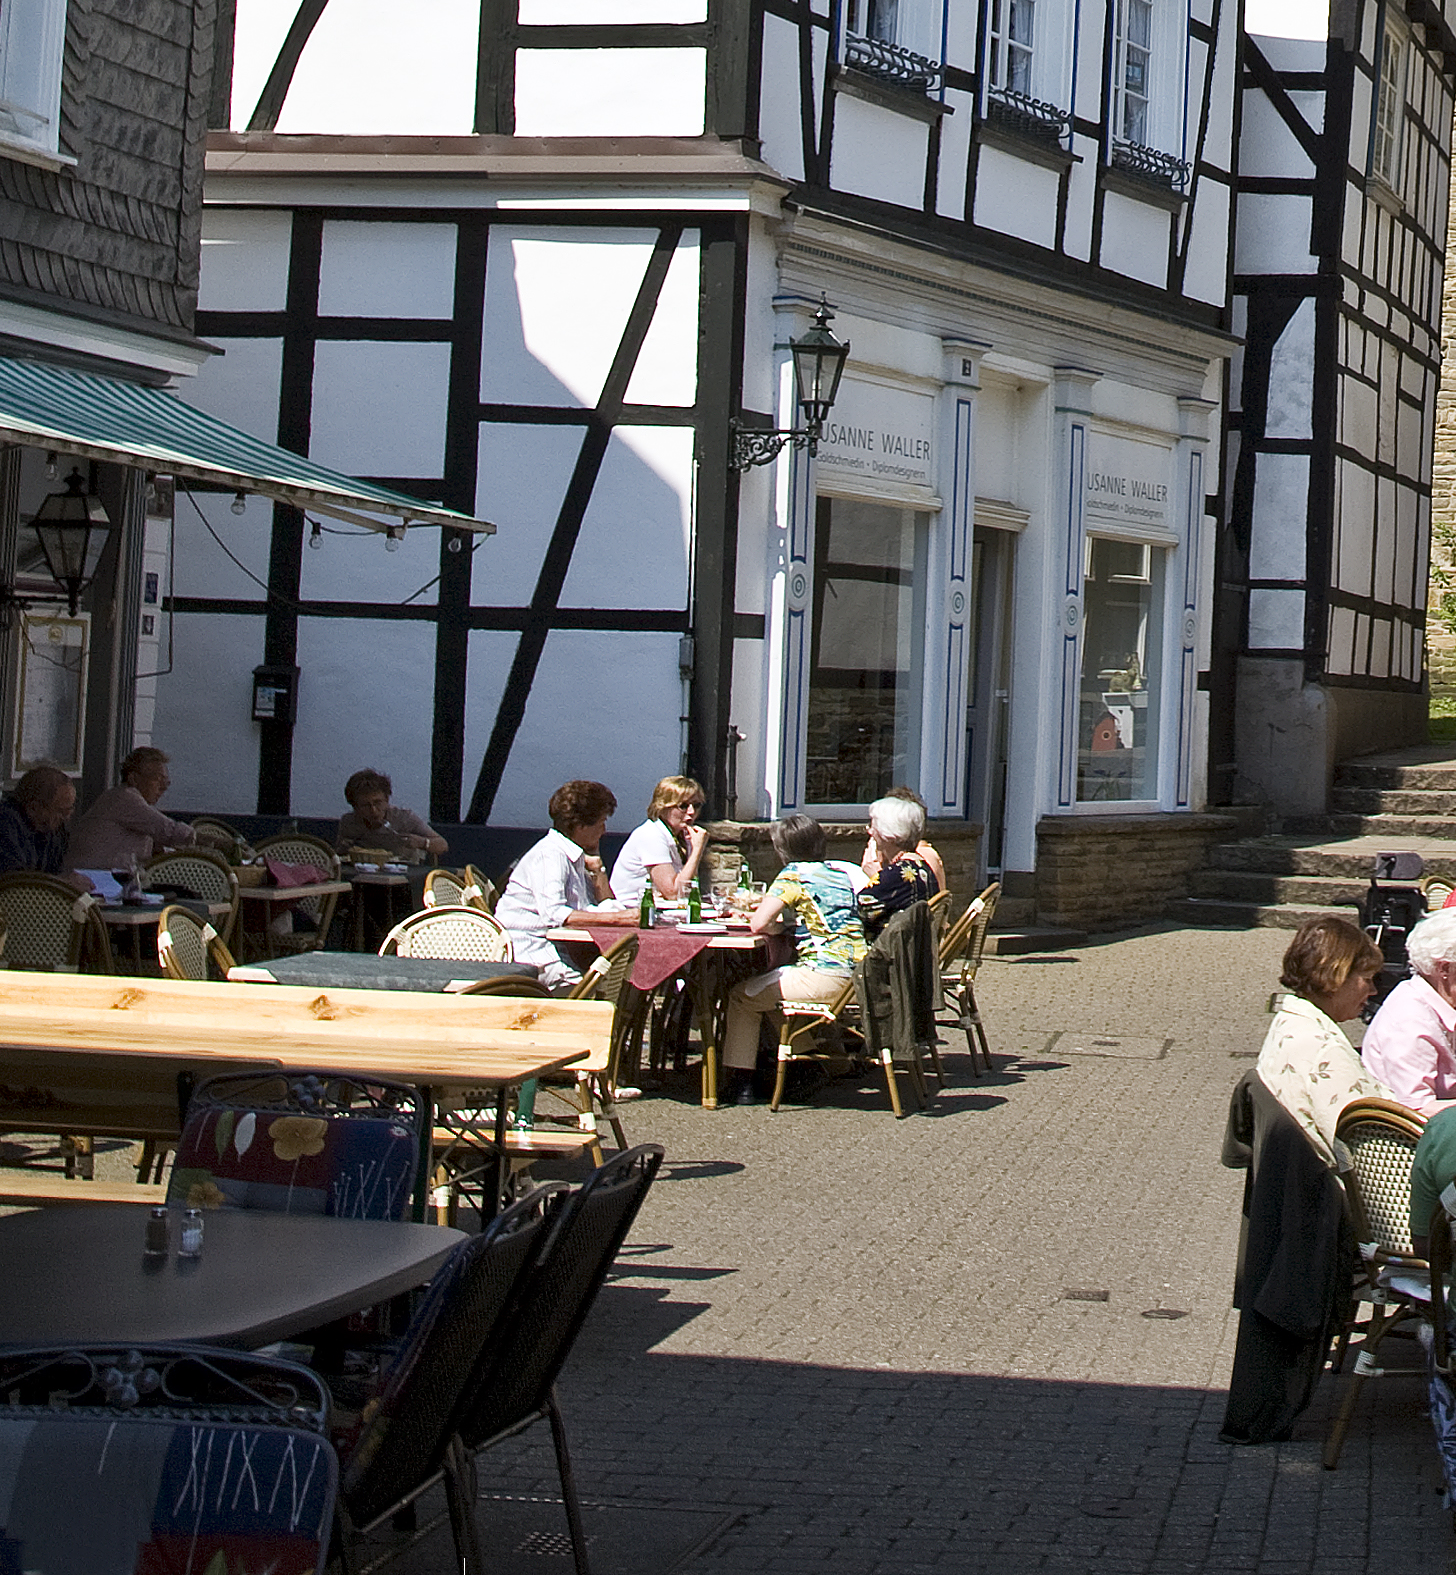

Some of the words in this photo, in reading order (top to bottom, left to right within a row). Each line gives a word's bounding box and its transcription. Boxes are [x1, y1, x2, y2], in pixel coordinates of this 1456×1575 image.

[821, 422, 875, 451] USANNE
[881, 433, 931, 462] WALLER
[1087, 472, 1127, 497] USANNE
[1131, 480, 1169, 503] WALLER
